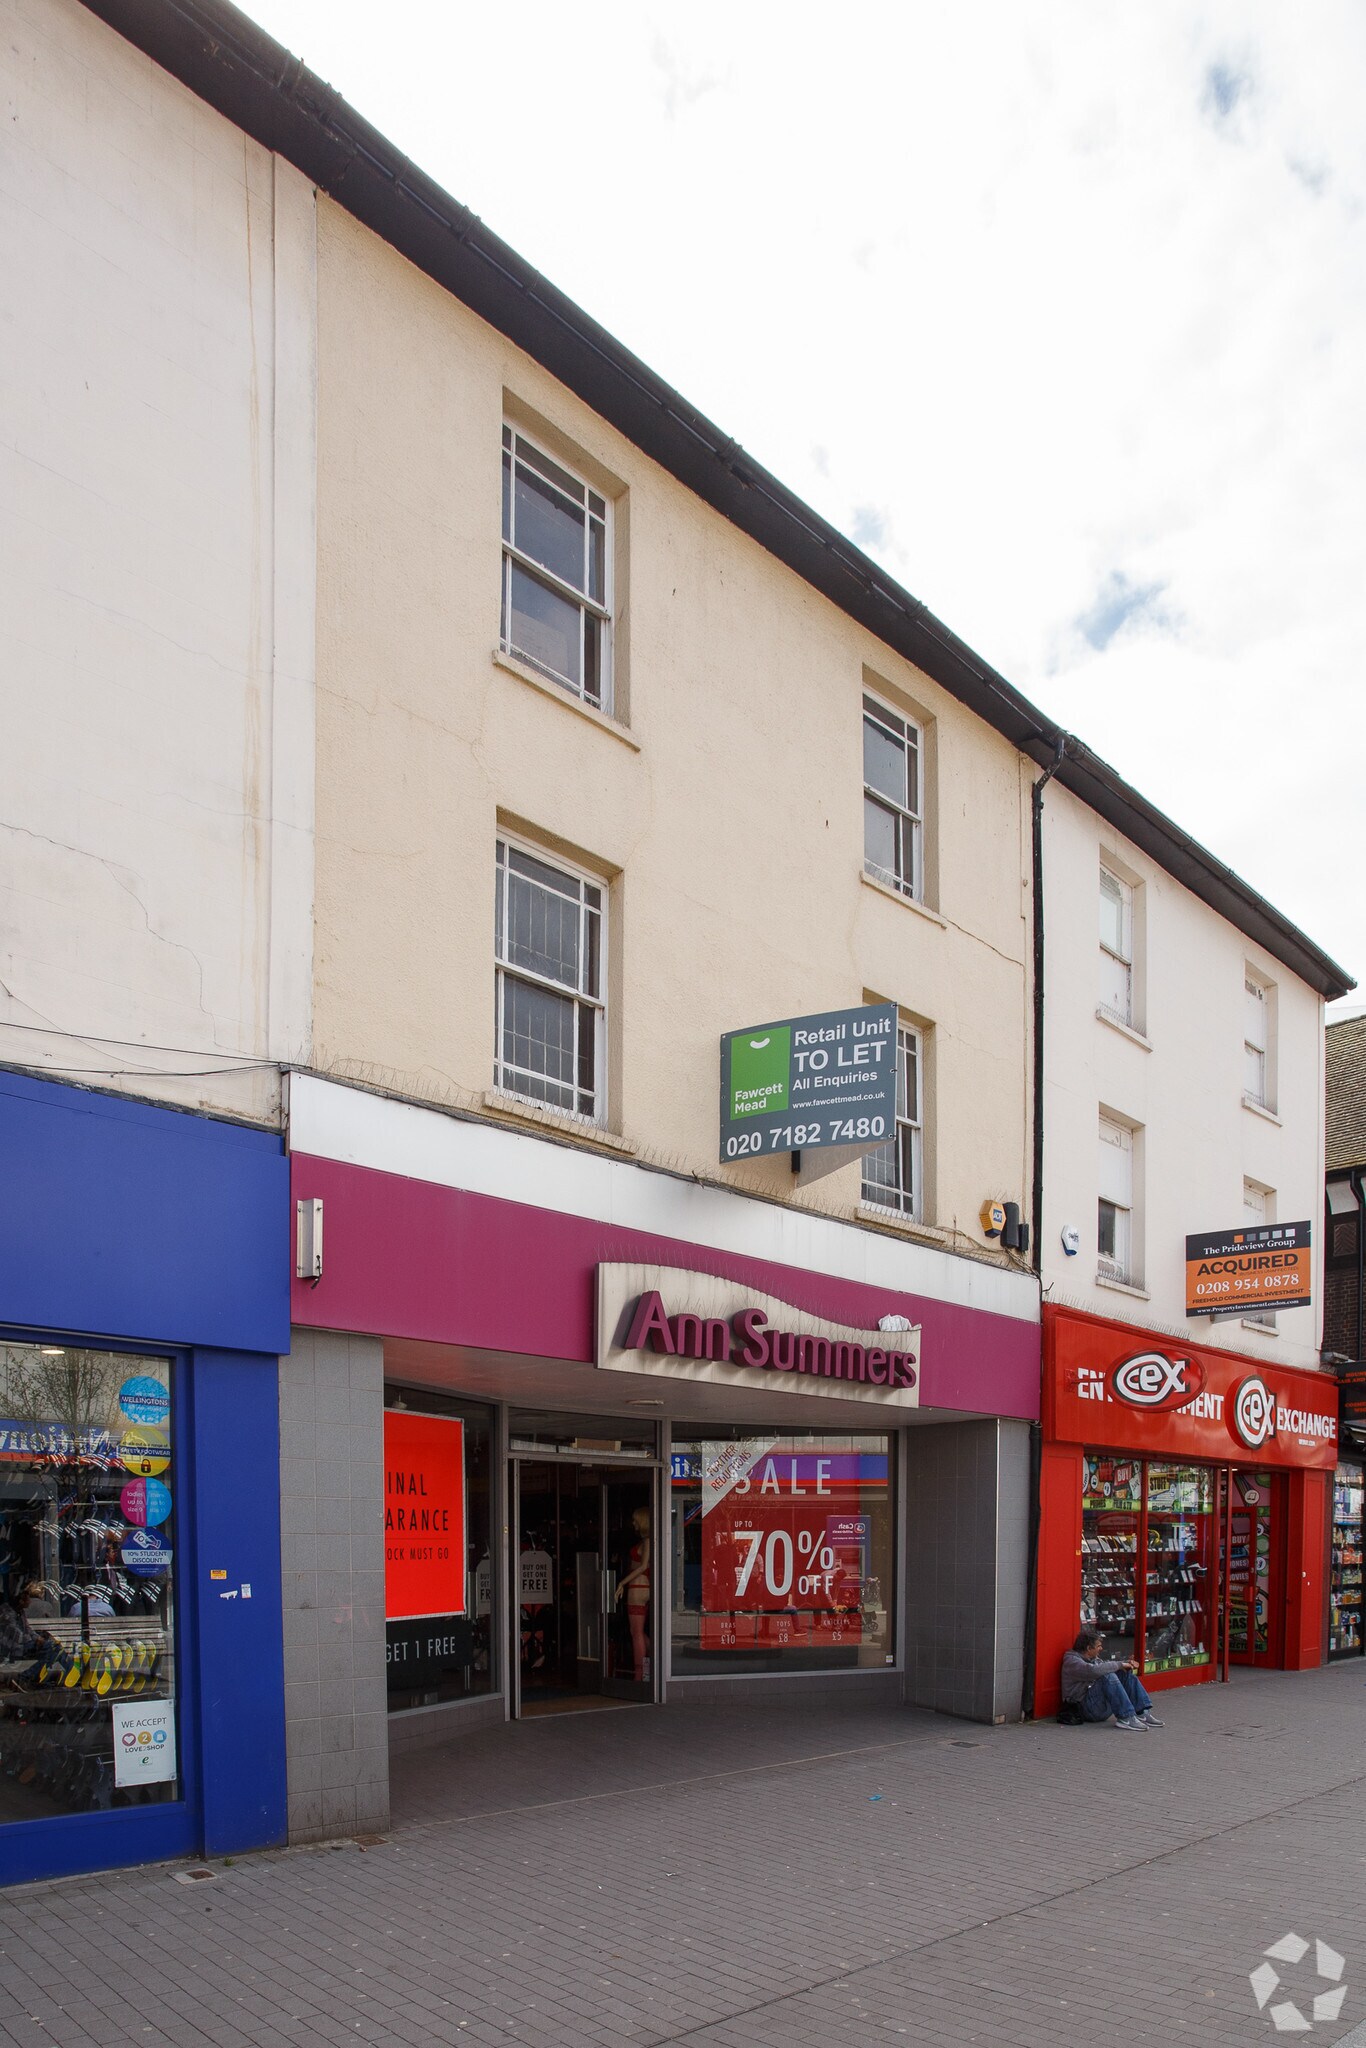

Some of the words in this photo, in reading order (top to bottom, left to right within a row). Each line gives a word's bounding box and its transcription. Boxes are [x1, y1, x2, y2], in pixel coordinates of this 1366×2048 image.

[794, 1024, 846, 1047] Retail
[852, 1018, 891, 1037] Unit
[794, 1049, 829, 1073] TO
[837, 1040, 887, 1067] LET
[793, 1078, 810, 1091] All
[814, 1071, 878, 1088] Enquiries
[735, 1083, 783, 1101] Fawcett
[792, 1091, 885, 1109] www.fawcettmead.co.uk
[735, 1098, 767, 1114] Mead
[726, 1131, 762, 1157] 020
[769, 1122, 821, 1148] 7182
[829, 1116, 885, 1141] 7480
[1203, 1247, 1220, 1255] The
[1222, 1241, 1265, 1253] Prideview
[1267, 1239, 1296, 1248] Group
[1197, 1253, 1299, 1276] ACQUIRED
[1196, 1281, 1230, 1295] 0208
[1234, 1278, 1260, 1290] 954
[1264, 1273, 1299, 1287] 0878
[1192, 1296, 1223, 1304] FREEHOLD
[1224, 1292, 1264, 1301] COMMERCIAL
[1264, 1288, 1304, 1297] INVESTMENT
[1197, 1299, 1299, 1313] www.PropertyInvestmentLondon.com
[624, 1289, 731, 1362] Ann
[733, 1307, 917, 1389] Summers
[121, 1396, 168, 1406] WELLINGTONS
[1276, 1406, 1336, 1439] EXCHANGE
[707, 1443, 740, 1477] FURTHER
[710, 1450, 752, 1492] REDUCTIONS
[734, 1458, 831, 1494] SALE
[387, 1471, 428, 1497] INAL
[384, 1508, 449, 1531] ARANCE
[387, 1548, 405, 1561] OCK
[410, 1547, 433, 1560] MUST
[437, 1547, 449, 1560] GO
[734, 1530, 834, 1596] 70%
[522, 1579, 548, 1590] FREE
[798, 1575, 834, 1595] OFF
[776, 1620, 790, 1628] TOYS
[720, 1634, 735, 1645] £10
[778, 1632, 788, 1642] £8
[831, 1631, 842, 1641] £5
[385, 1642, 408, 1663] GET
[428, 1636, 456, 1658] FREE
[121, 1720, 134, 1728] WE
[136, 1717, 167, 1727] ACCEPT
